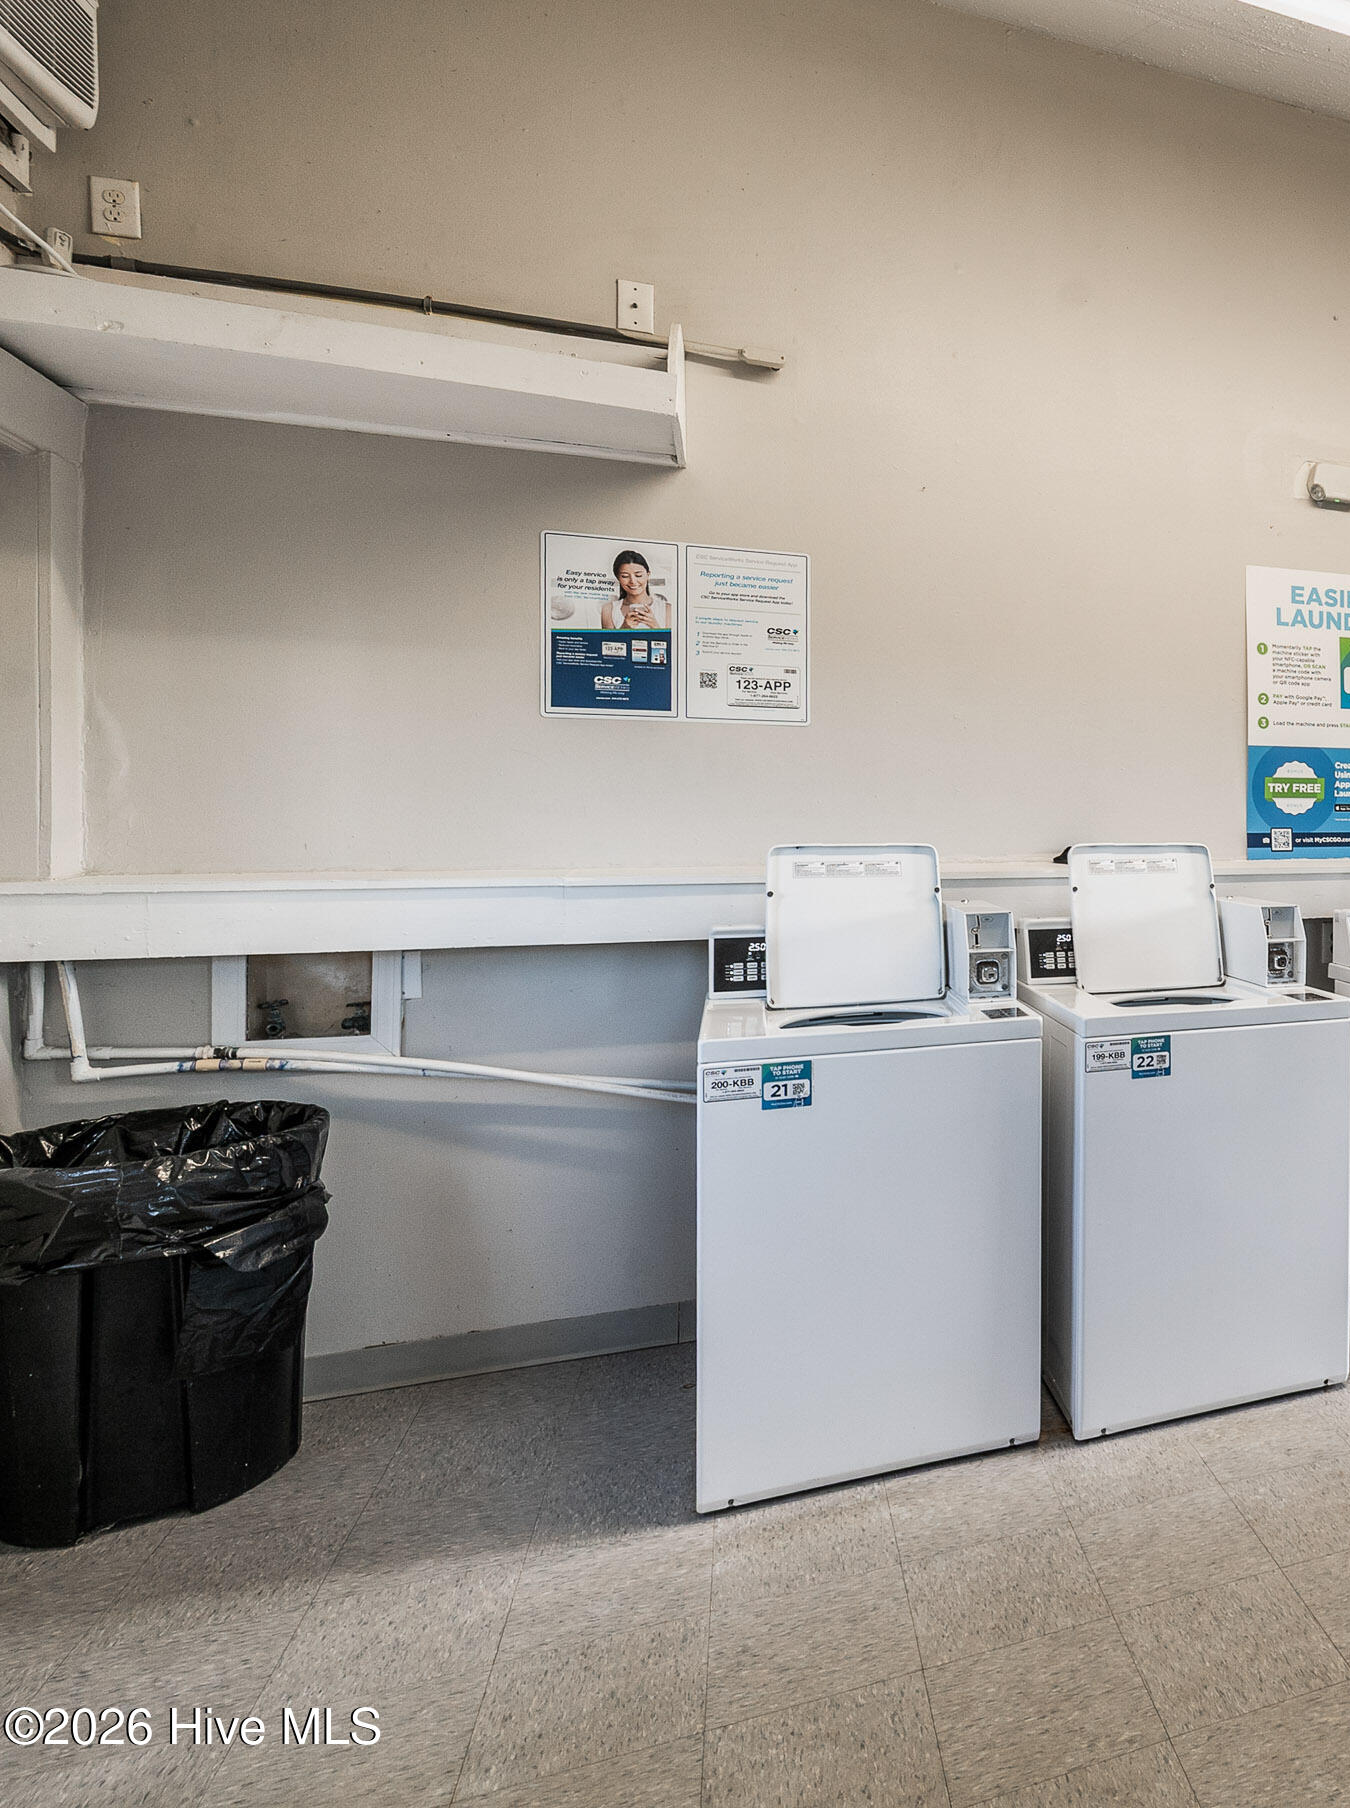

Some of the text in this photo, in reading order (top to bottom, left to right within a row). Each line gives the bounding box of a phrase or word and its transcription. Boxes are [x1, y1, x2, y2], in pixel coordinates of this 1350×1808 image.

[700, 571, 734, 580] Reporting
[730, 581, 756, 589] became
[594, 676, 622, 684] CSC
[736, 680, 791, 691] 123-APP
[1261, 719, 1266, 727] 3
[1267, 783, 1321, 793] TRY FREE
[1335, 781, 1350, 789] App
[748, 943, 766, 951] 250
[1092, 1052, 1125, 1060] 199-KBB
[1137, 1056, 1154, 1068] 22
[711, 1078, 754, 1089] 200-KBB
[770, 1084, 788, 1097] 21
